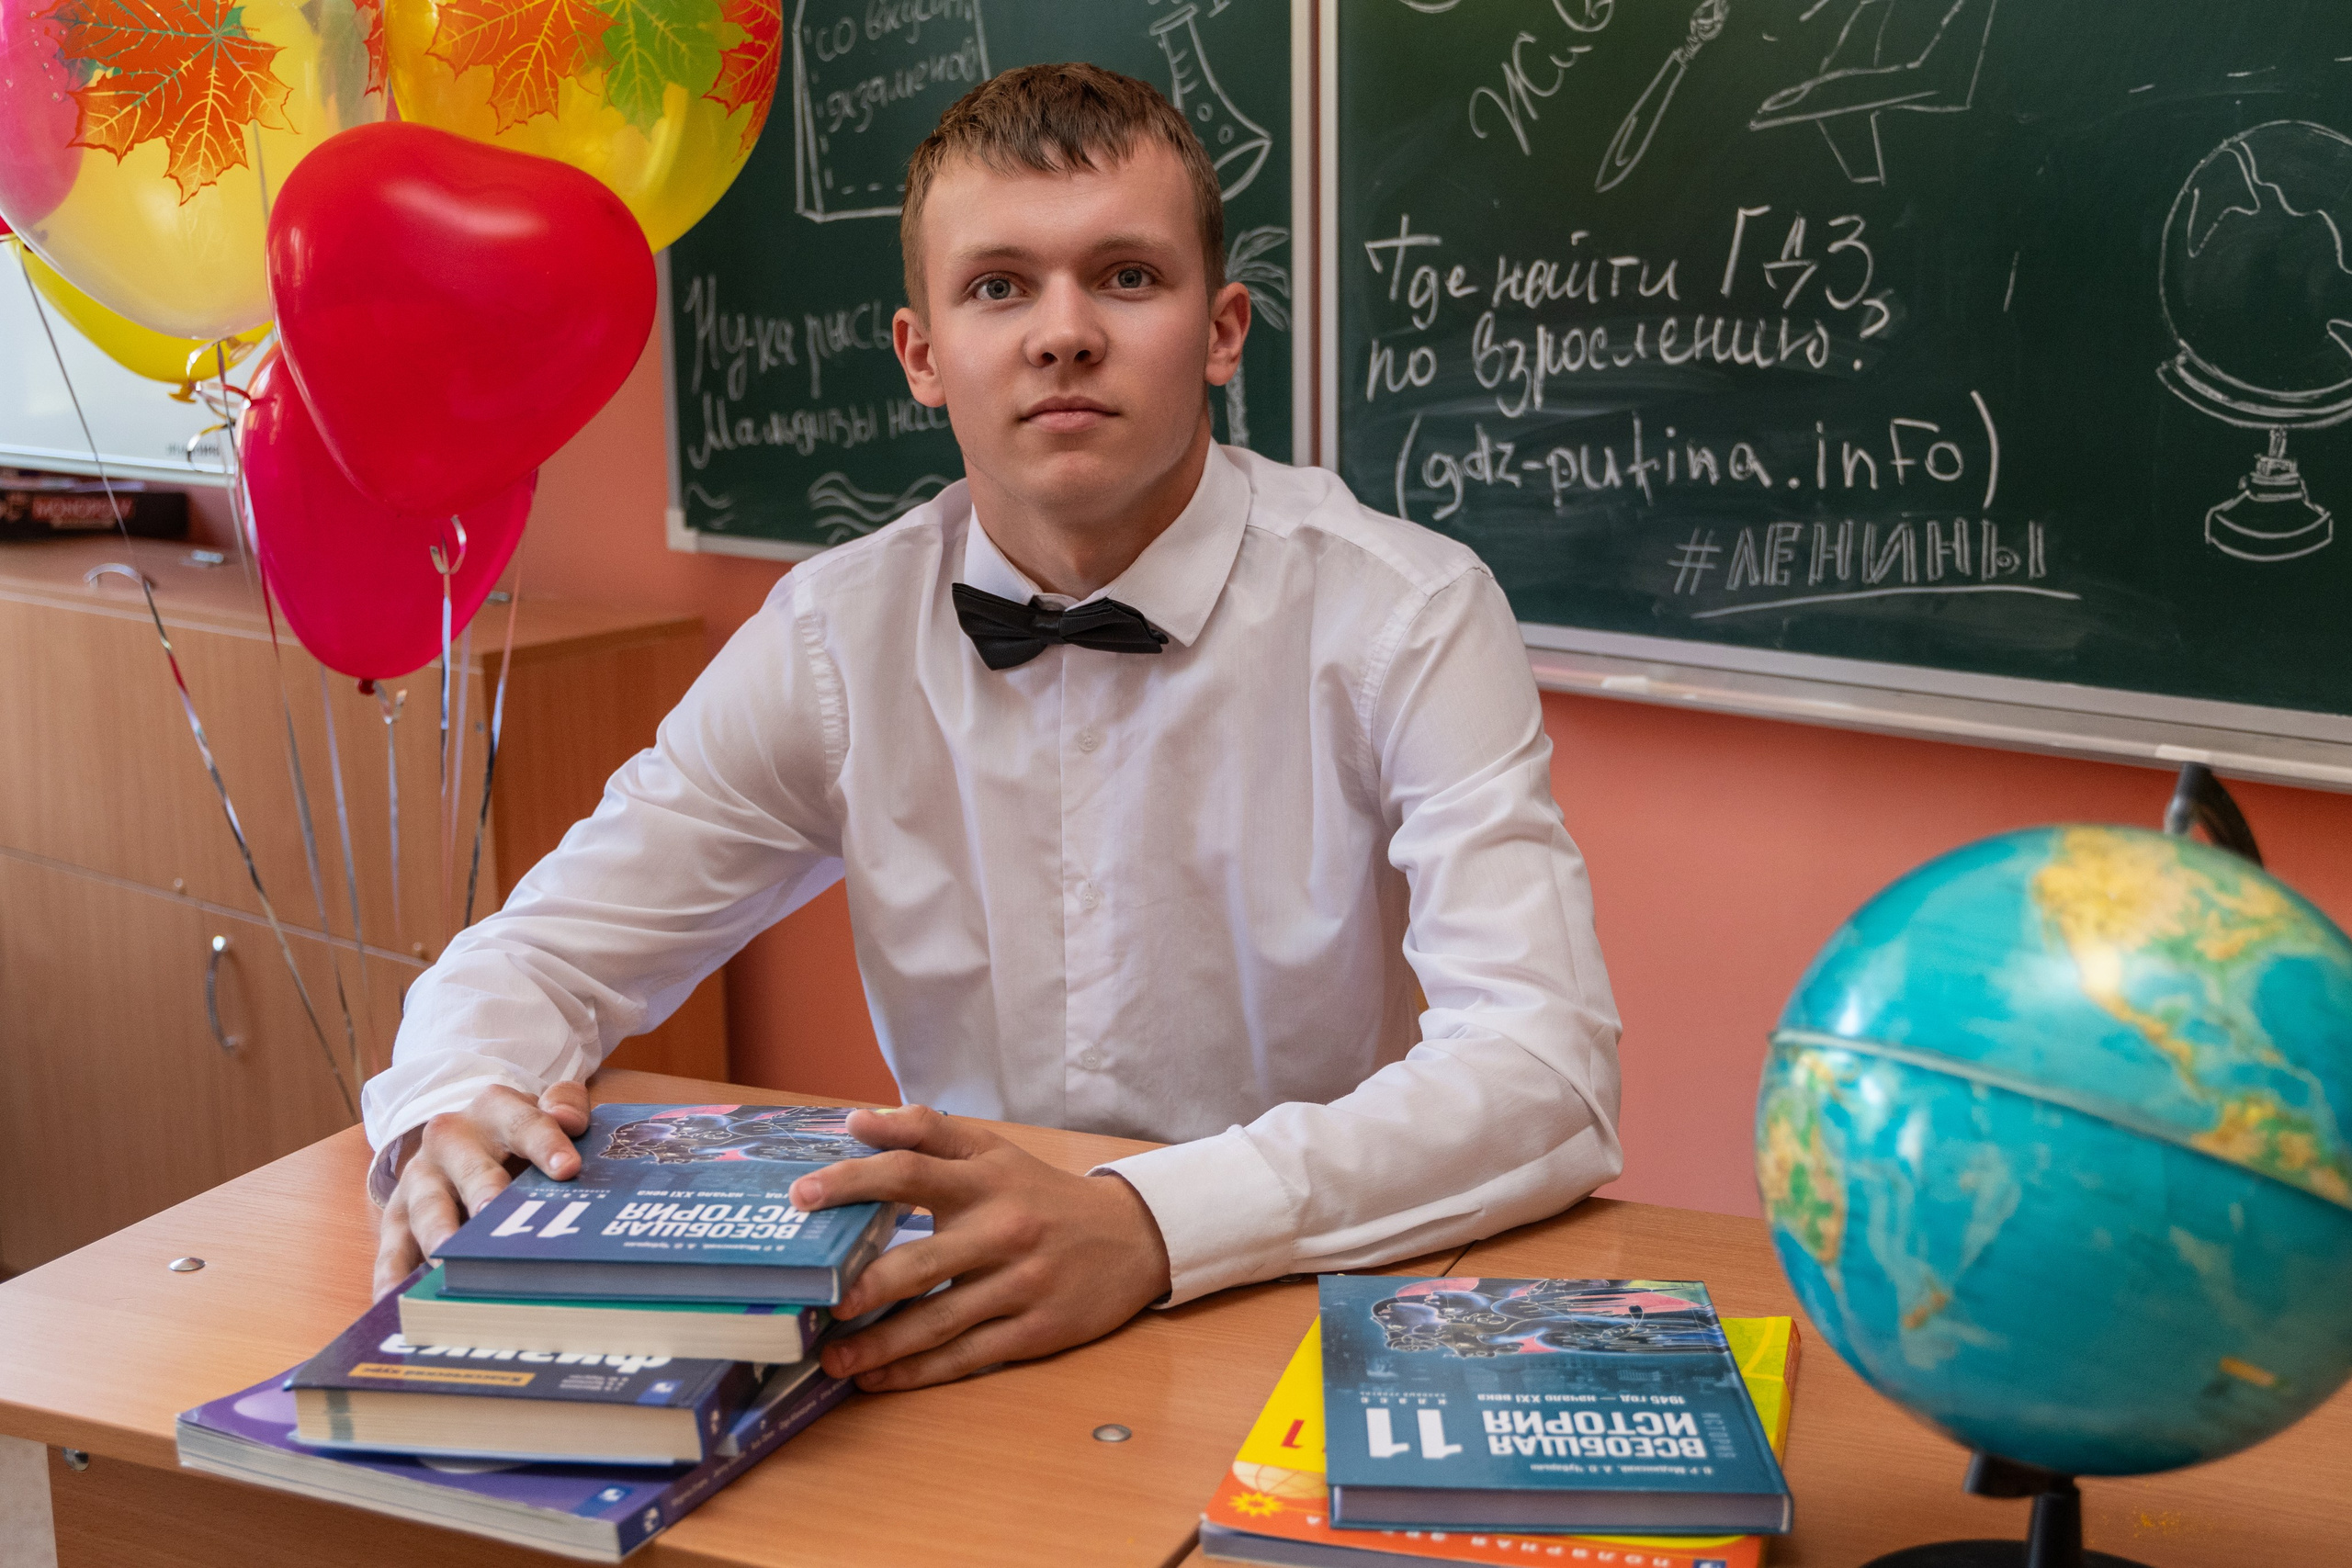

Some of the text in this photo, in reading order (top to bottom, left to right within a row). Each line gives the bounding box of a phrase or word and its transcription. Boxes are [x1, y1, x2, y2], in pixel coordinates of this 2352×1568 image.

[815, 16, 858, 62] со
[1490, 231, 1681, 309] найти
[1720, 205, 1875, 310] ГДЗ
[1366, 338, 1438, 402] по
[490, 1201, 593, 1238] 11
[615, 1202, 810, 1224] ИСТОРИЯ
[600, 1219, 802, 1240] ВСЕОБЩАЯ
[1477, 1393, 1512, 1402] века
[1516, 1393, 1542, 1404] XXI
[1544, 1394, 1597, 1403] начало
[1619, 1394, 1646, 1403] год
[1649, 1395, 1687, 1405] 1945
[1366, 1408, 1464, 1459] 11
[1482, 1411, 1699, 1437] ИСТОРИЯ
[1487, 1434, 1708, 1459] ВСЕОБЩАЯ
[1470, 1536, 1672, 1567] ПОЛЯРНАЯ
